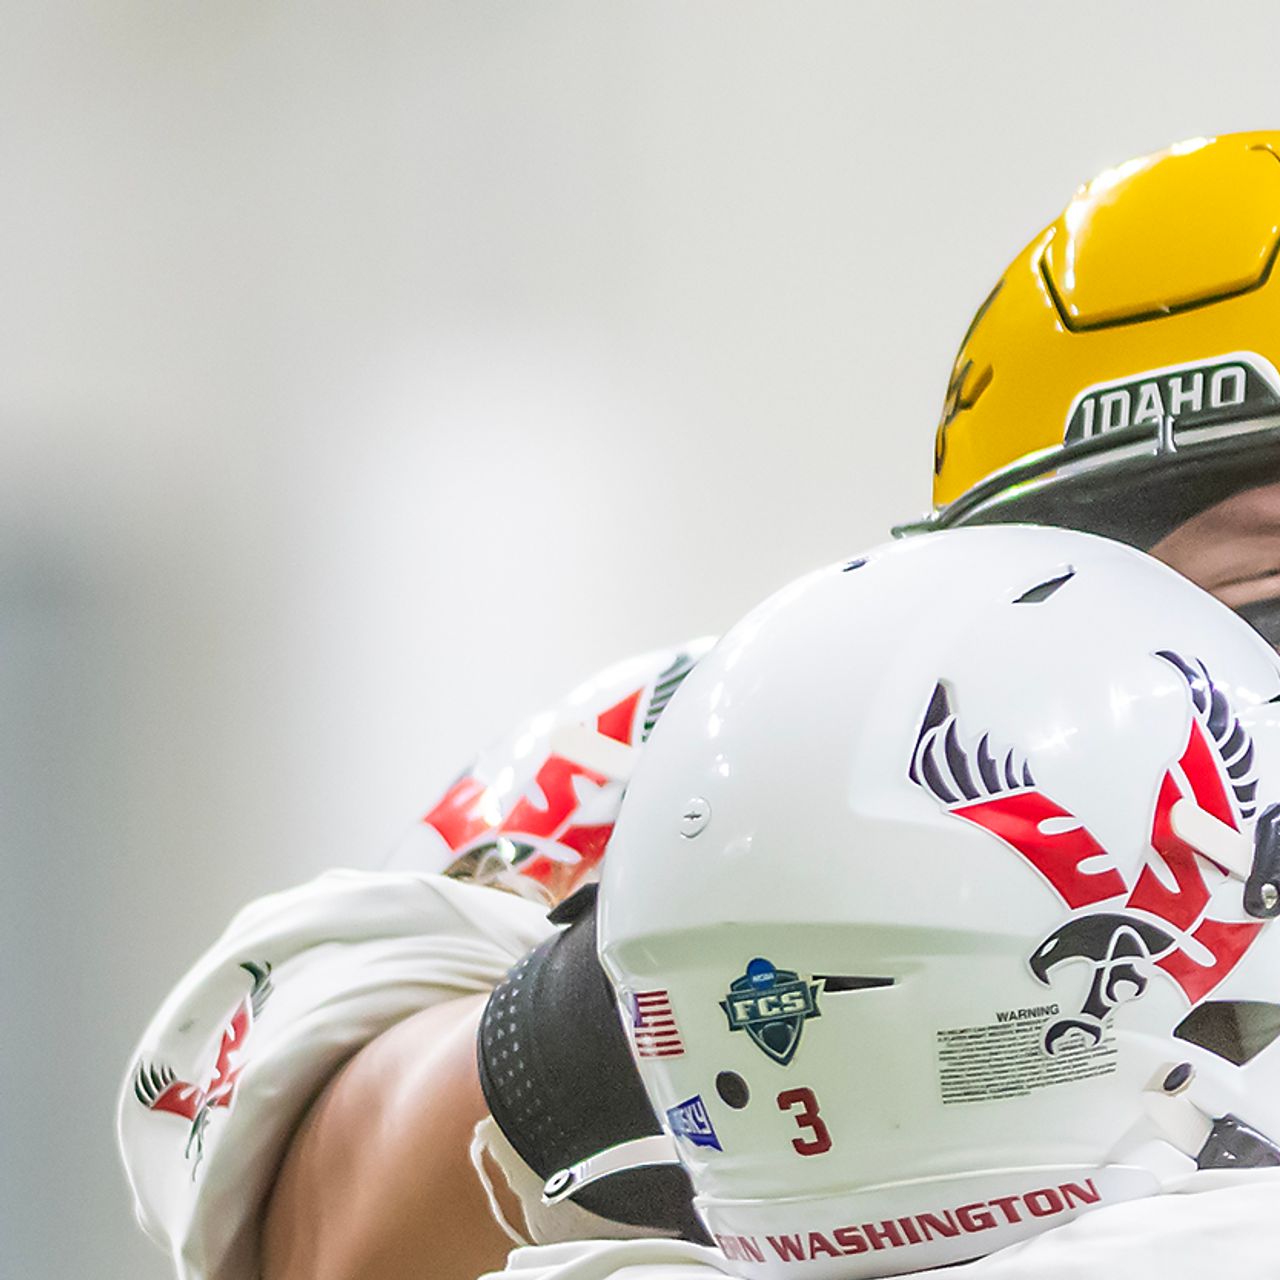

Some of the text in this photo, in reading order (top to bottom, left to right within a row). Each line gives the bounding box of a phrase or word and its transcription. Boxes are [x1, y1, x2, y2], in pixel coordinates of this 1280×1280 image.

[1081, 365, 1247, 440] IDAHO
[732, 990, 806, 1021] FCS
[996, 1003, 1060, 1022] WARNING
[776, 1087, 832, 1157] 3
[766, 1177, 1103, 1263] WASHINGTON
